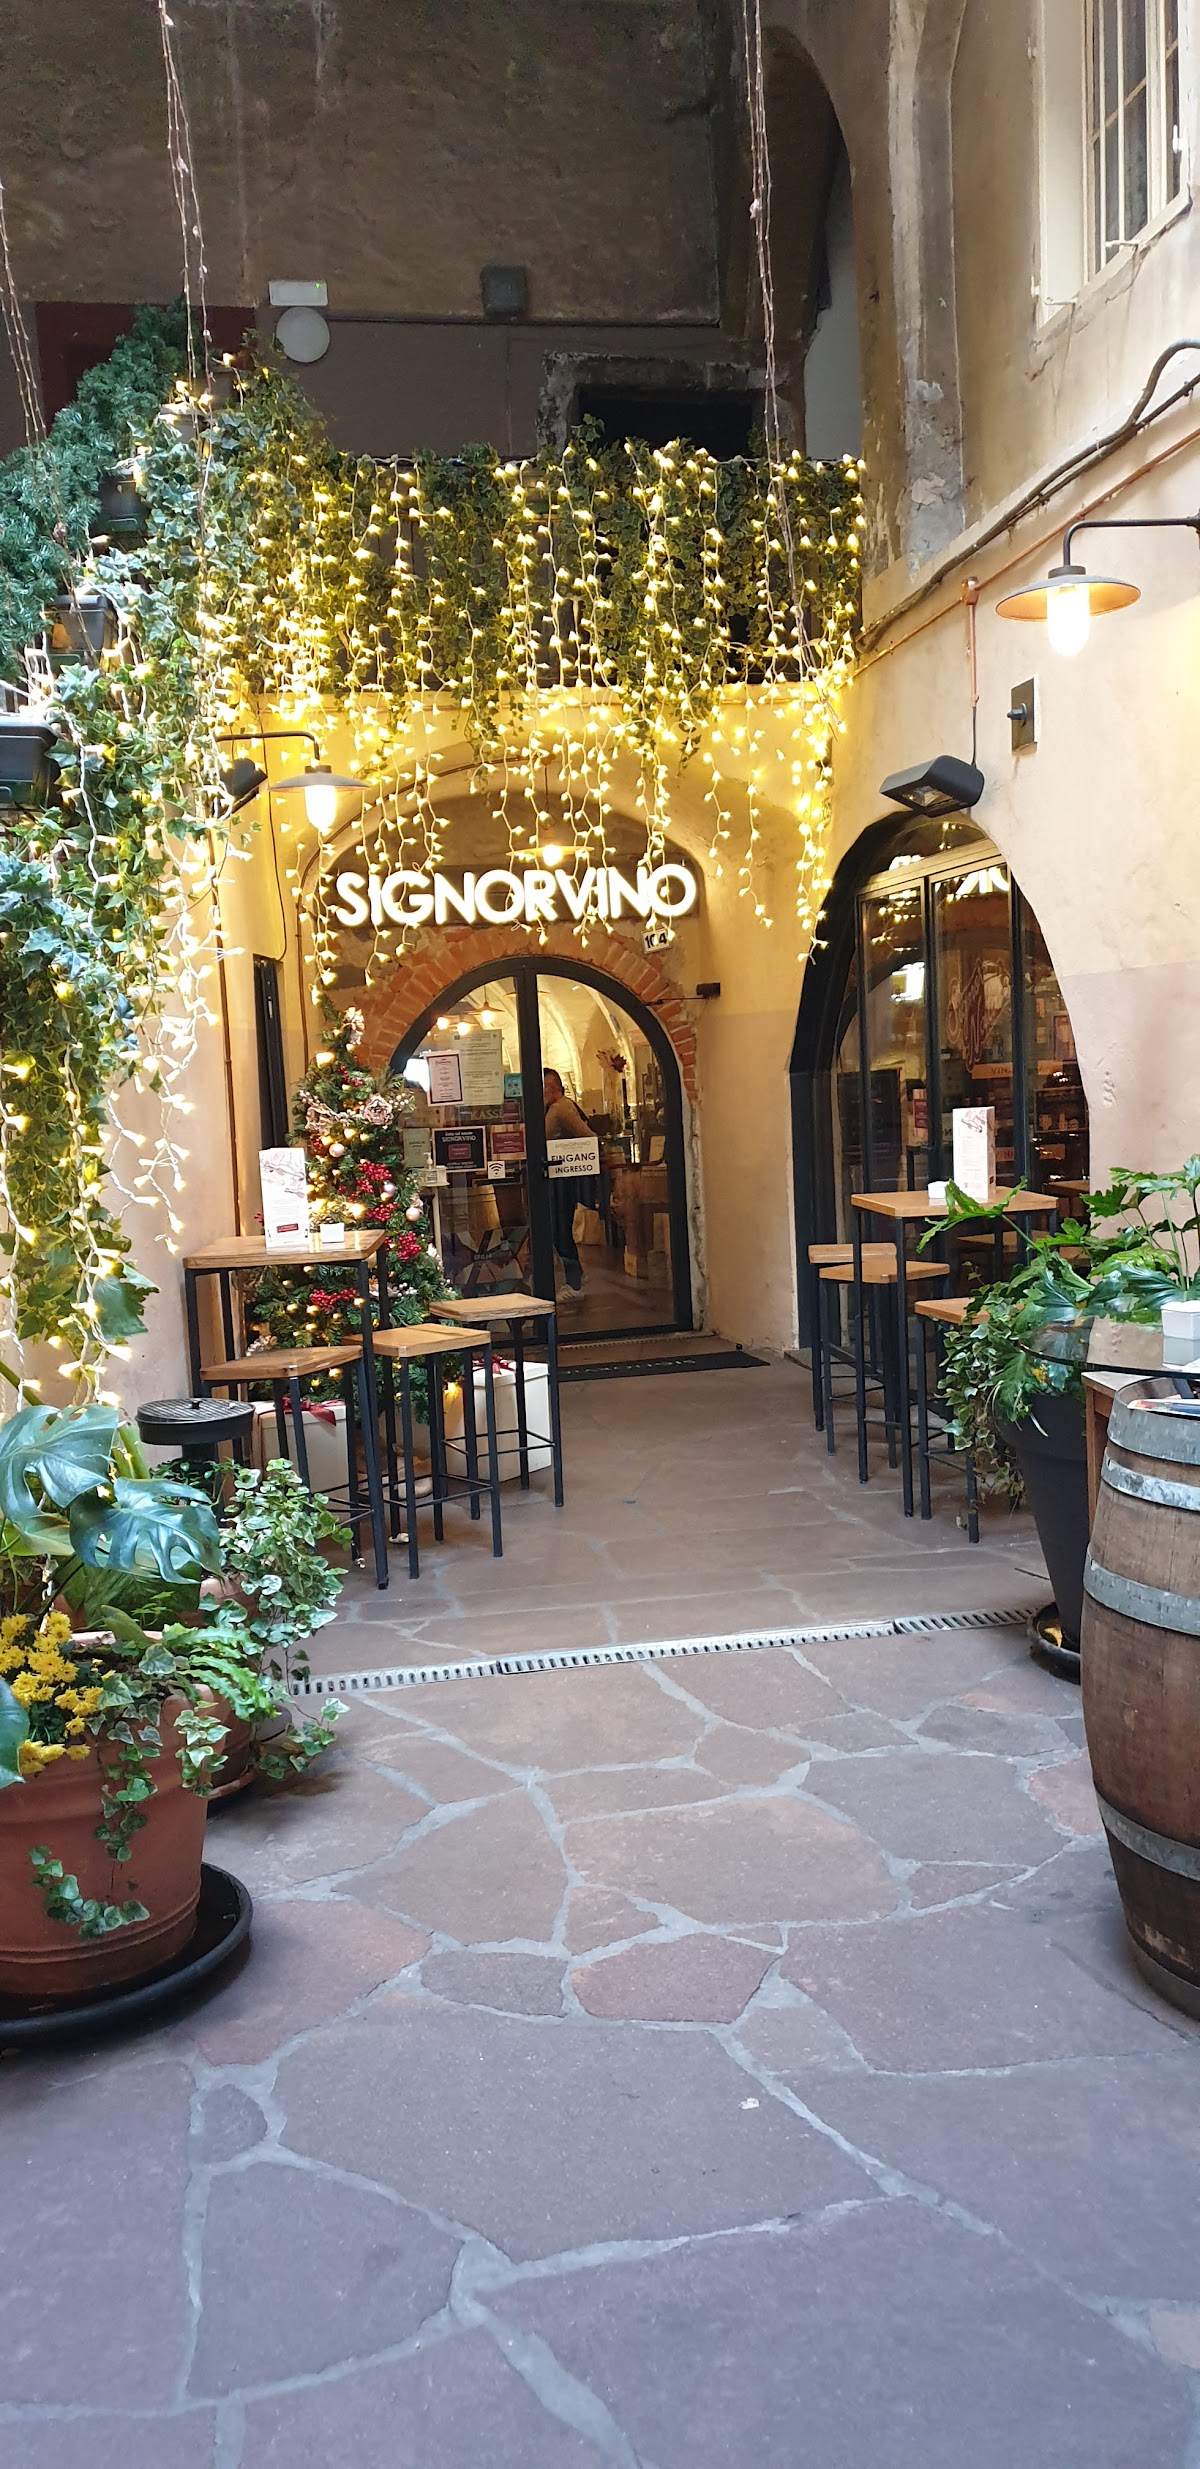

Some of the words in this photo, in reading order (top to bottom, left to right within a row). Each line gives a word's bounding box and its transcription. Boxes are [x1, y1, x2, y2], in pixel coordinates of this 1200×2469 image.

[335, 863, 697, 926] SIGNORVINO
[645, 932, 668, 948] 104
[551, 1152, 596, 1163] EINGANG
[555, 1164, 593, 1174] INGRESSO
